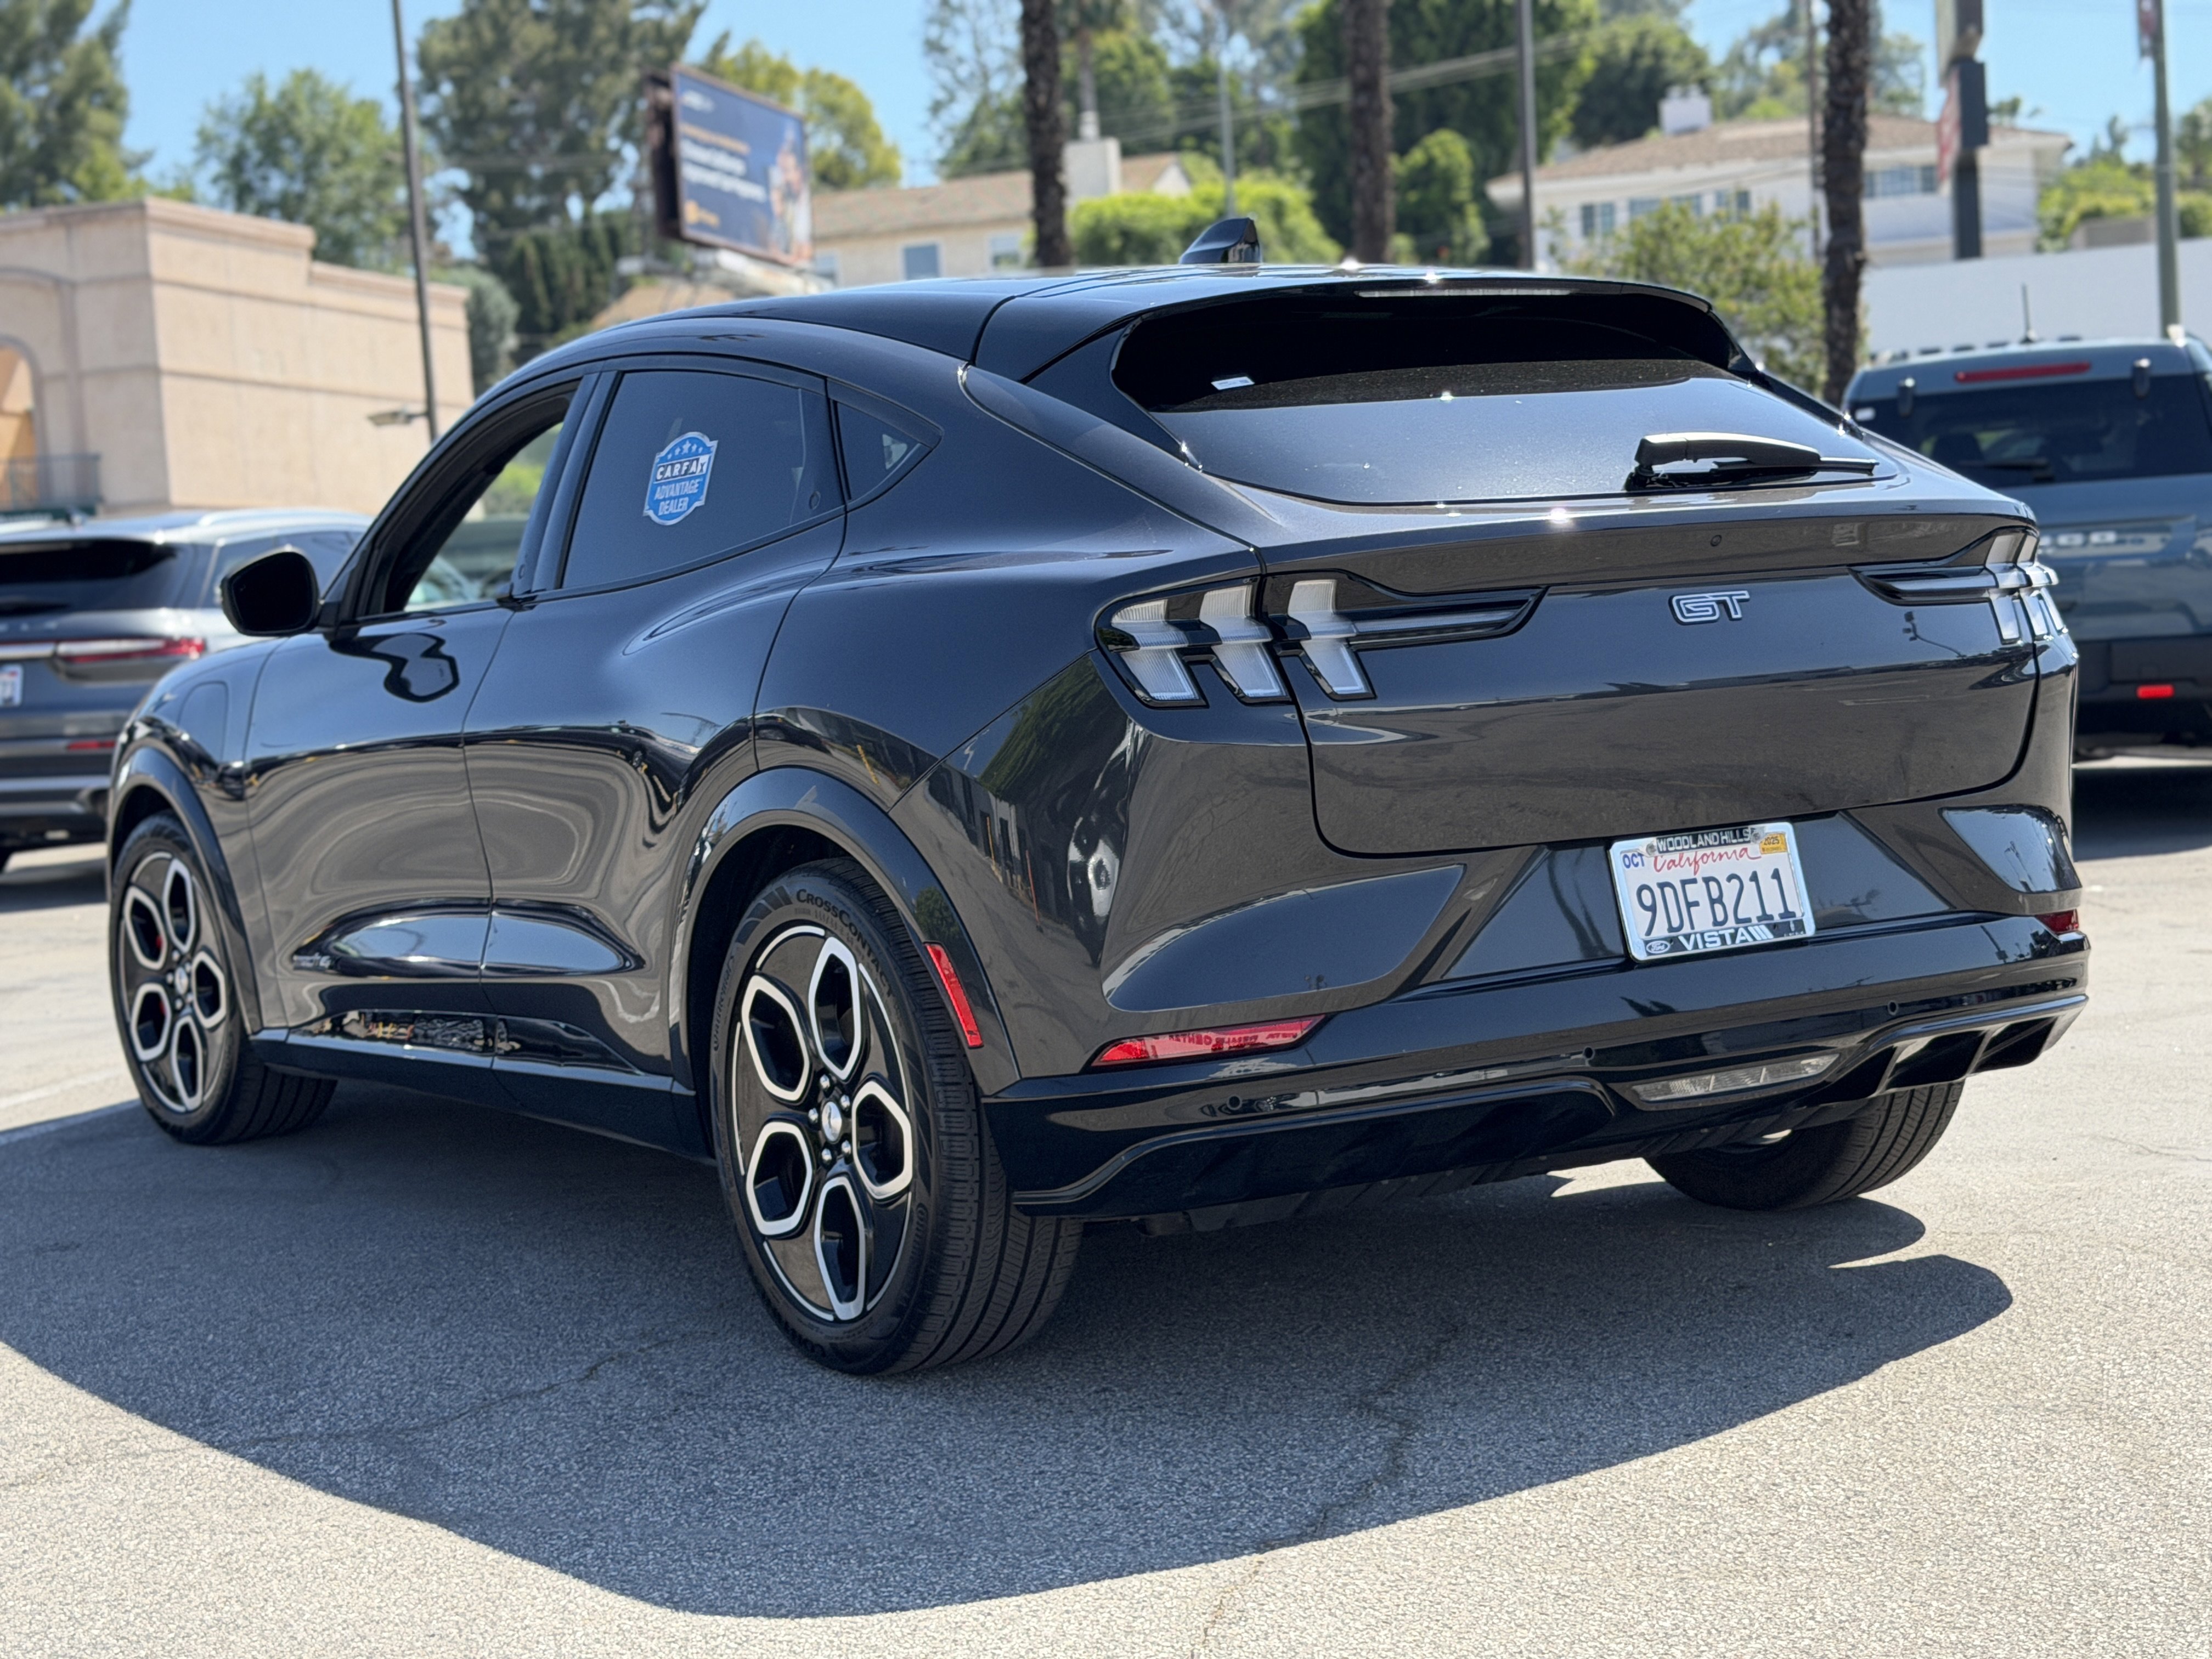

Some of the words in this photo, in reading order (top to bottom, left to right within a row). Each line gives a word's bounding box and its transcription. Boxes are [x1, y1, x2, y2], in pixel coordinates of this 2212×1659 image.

[657, 460, 707, 479] CARFAX
[654, 479, 699, 500] ADVANTAGE
[659, 497, 689, 515] DEALER
[1672, 590, 1750, 623] GT
[1657, 831, 1719, 852] WOODLAND
[1720, 828, 1750, 844] HILLS
[1622, 853, 1645, 869] OCT
[1654, 847, 1762, 876] California
[1636, 867, 1796, 936] 9DFB211
[1678, 926, 1754, 951] VISTA
